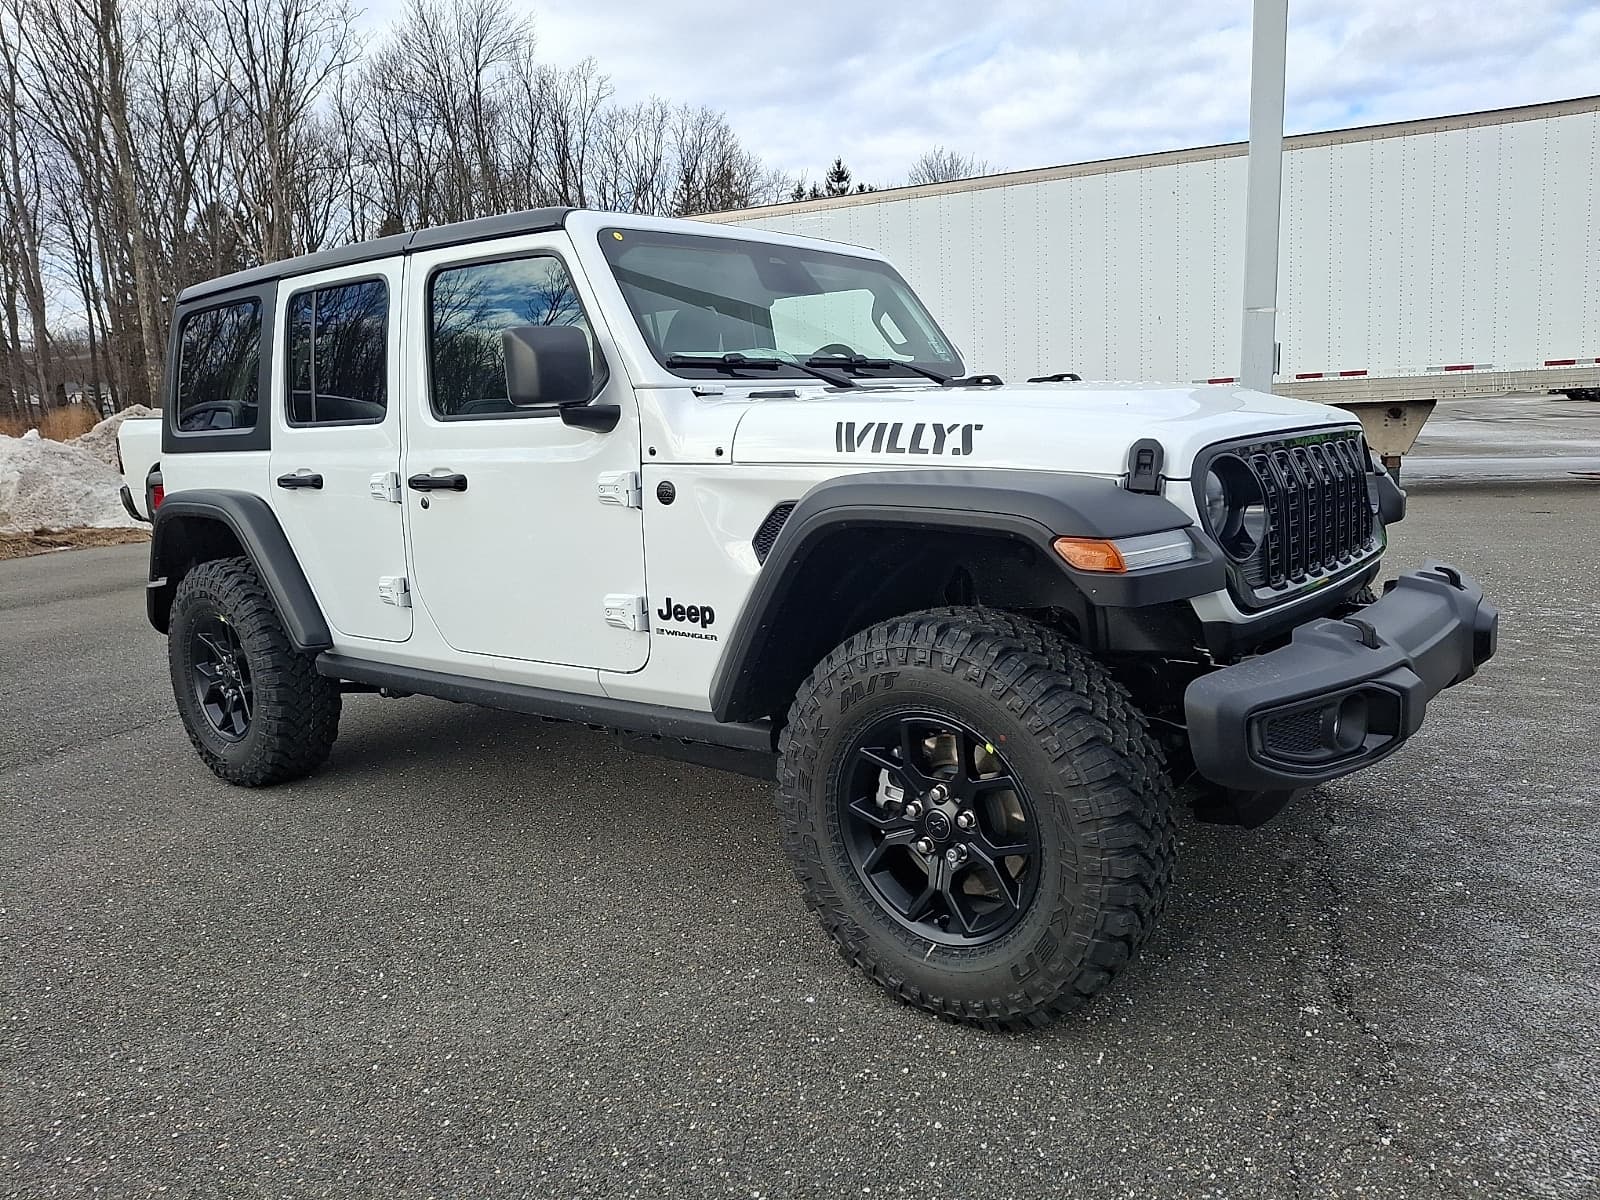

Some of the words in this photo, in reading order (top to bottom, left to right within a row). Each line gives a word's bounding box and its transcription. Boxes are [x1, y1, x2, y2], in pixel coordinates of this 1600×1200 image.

[836, 422, 983, 455] WILLYS
[658, 597, 714, 628] Jeep
[665, 629, 718, 641] WRANGLER
[840, 671, 901, 713] M/T
